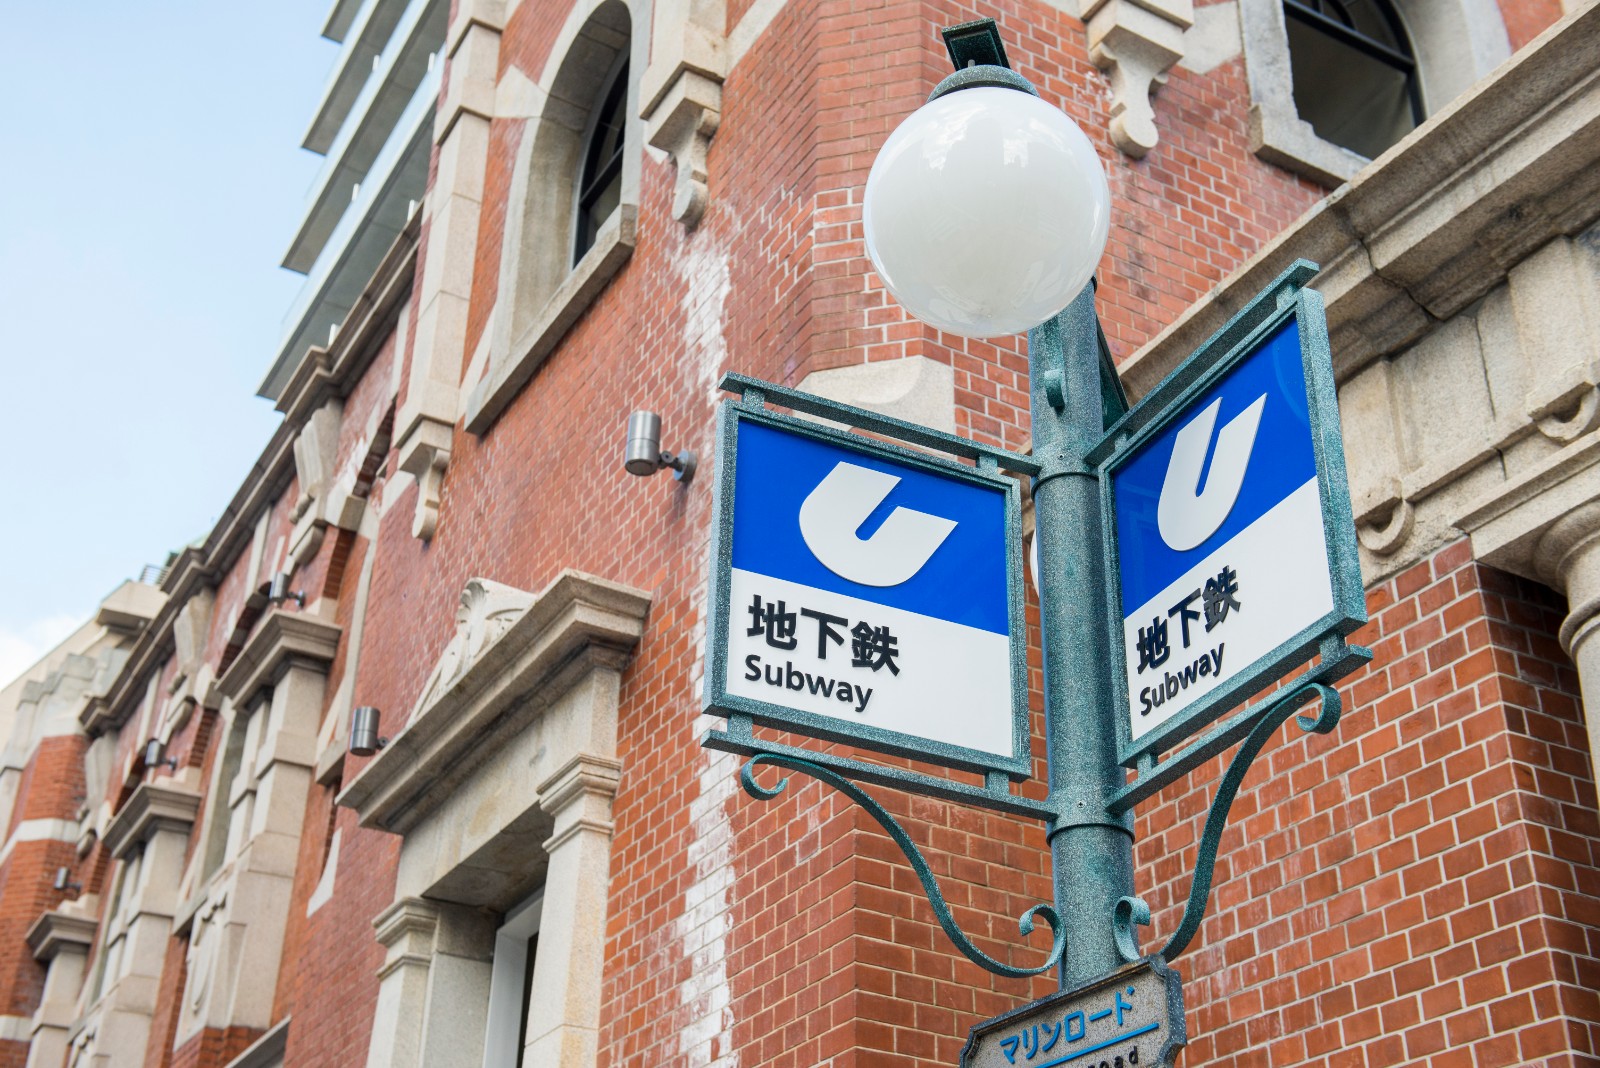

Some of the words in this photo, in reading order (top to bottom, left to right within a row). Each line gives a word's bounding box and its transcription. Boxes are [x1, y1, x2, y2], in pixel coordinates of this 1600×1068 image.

[746, 594, 901, 677] 地下鉄
[1136, 564, 1241, 675] 地下鉄
[744, 654, 873, 713] Subway
[1140, 642, 1225, 717] Subway
[1000, 985, 1135, 1065] マリンロード
